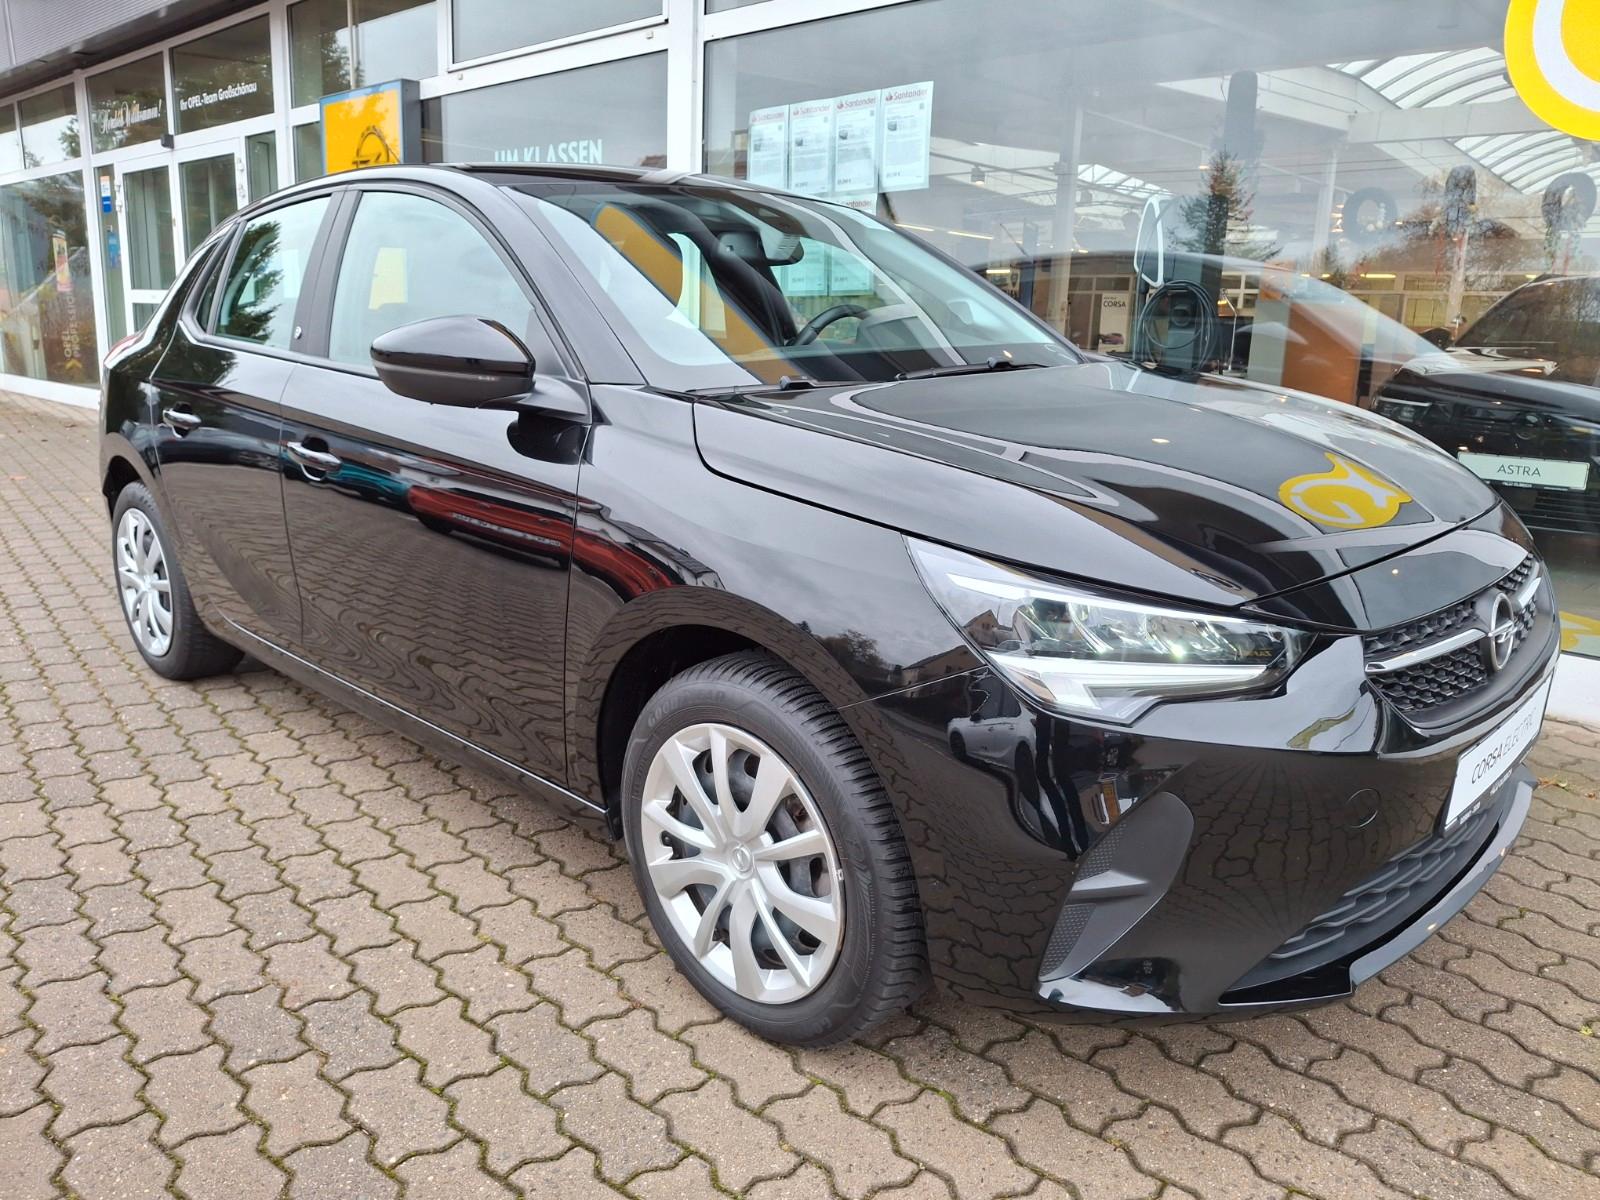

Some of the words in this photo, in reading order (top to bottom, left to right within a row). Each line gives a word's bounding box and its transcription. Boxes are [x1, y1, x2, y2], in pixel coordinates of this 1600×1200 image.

[1103, 300, 1127, 308] CORSA
[1497, 464, 1541, 477] ASTRA
[1471, 743, 1503, 784] CORSA
